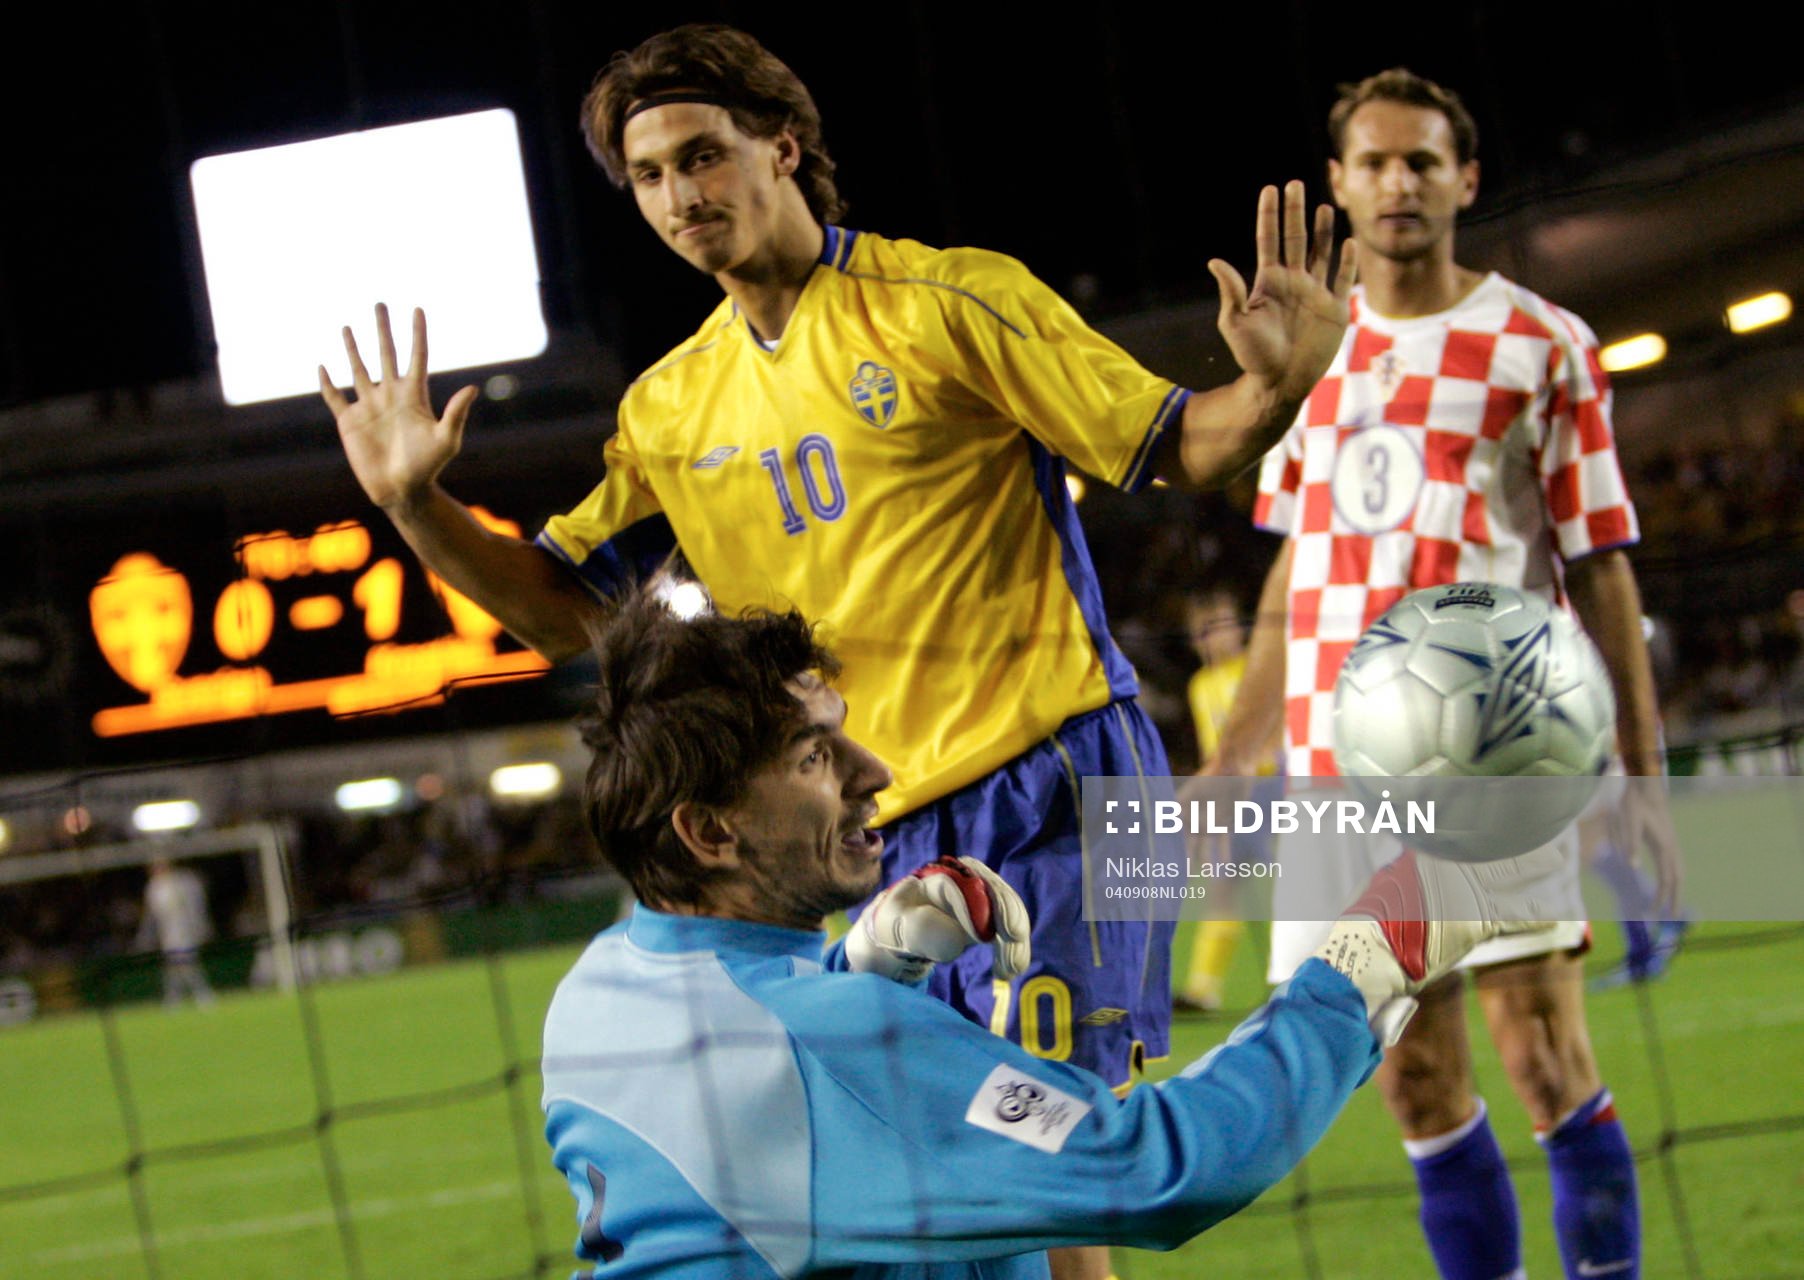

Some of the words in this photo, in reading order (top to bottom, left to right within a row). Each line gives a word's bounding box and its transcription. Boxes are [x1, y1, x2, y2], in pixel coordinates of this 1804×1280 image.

[759, 433, 846, 536] 10
[1363, 443, 1391, 514] 3
[990, 975, 1073, 1062] 10
